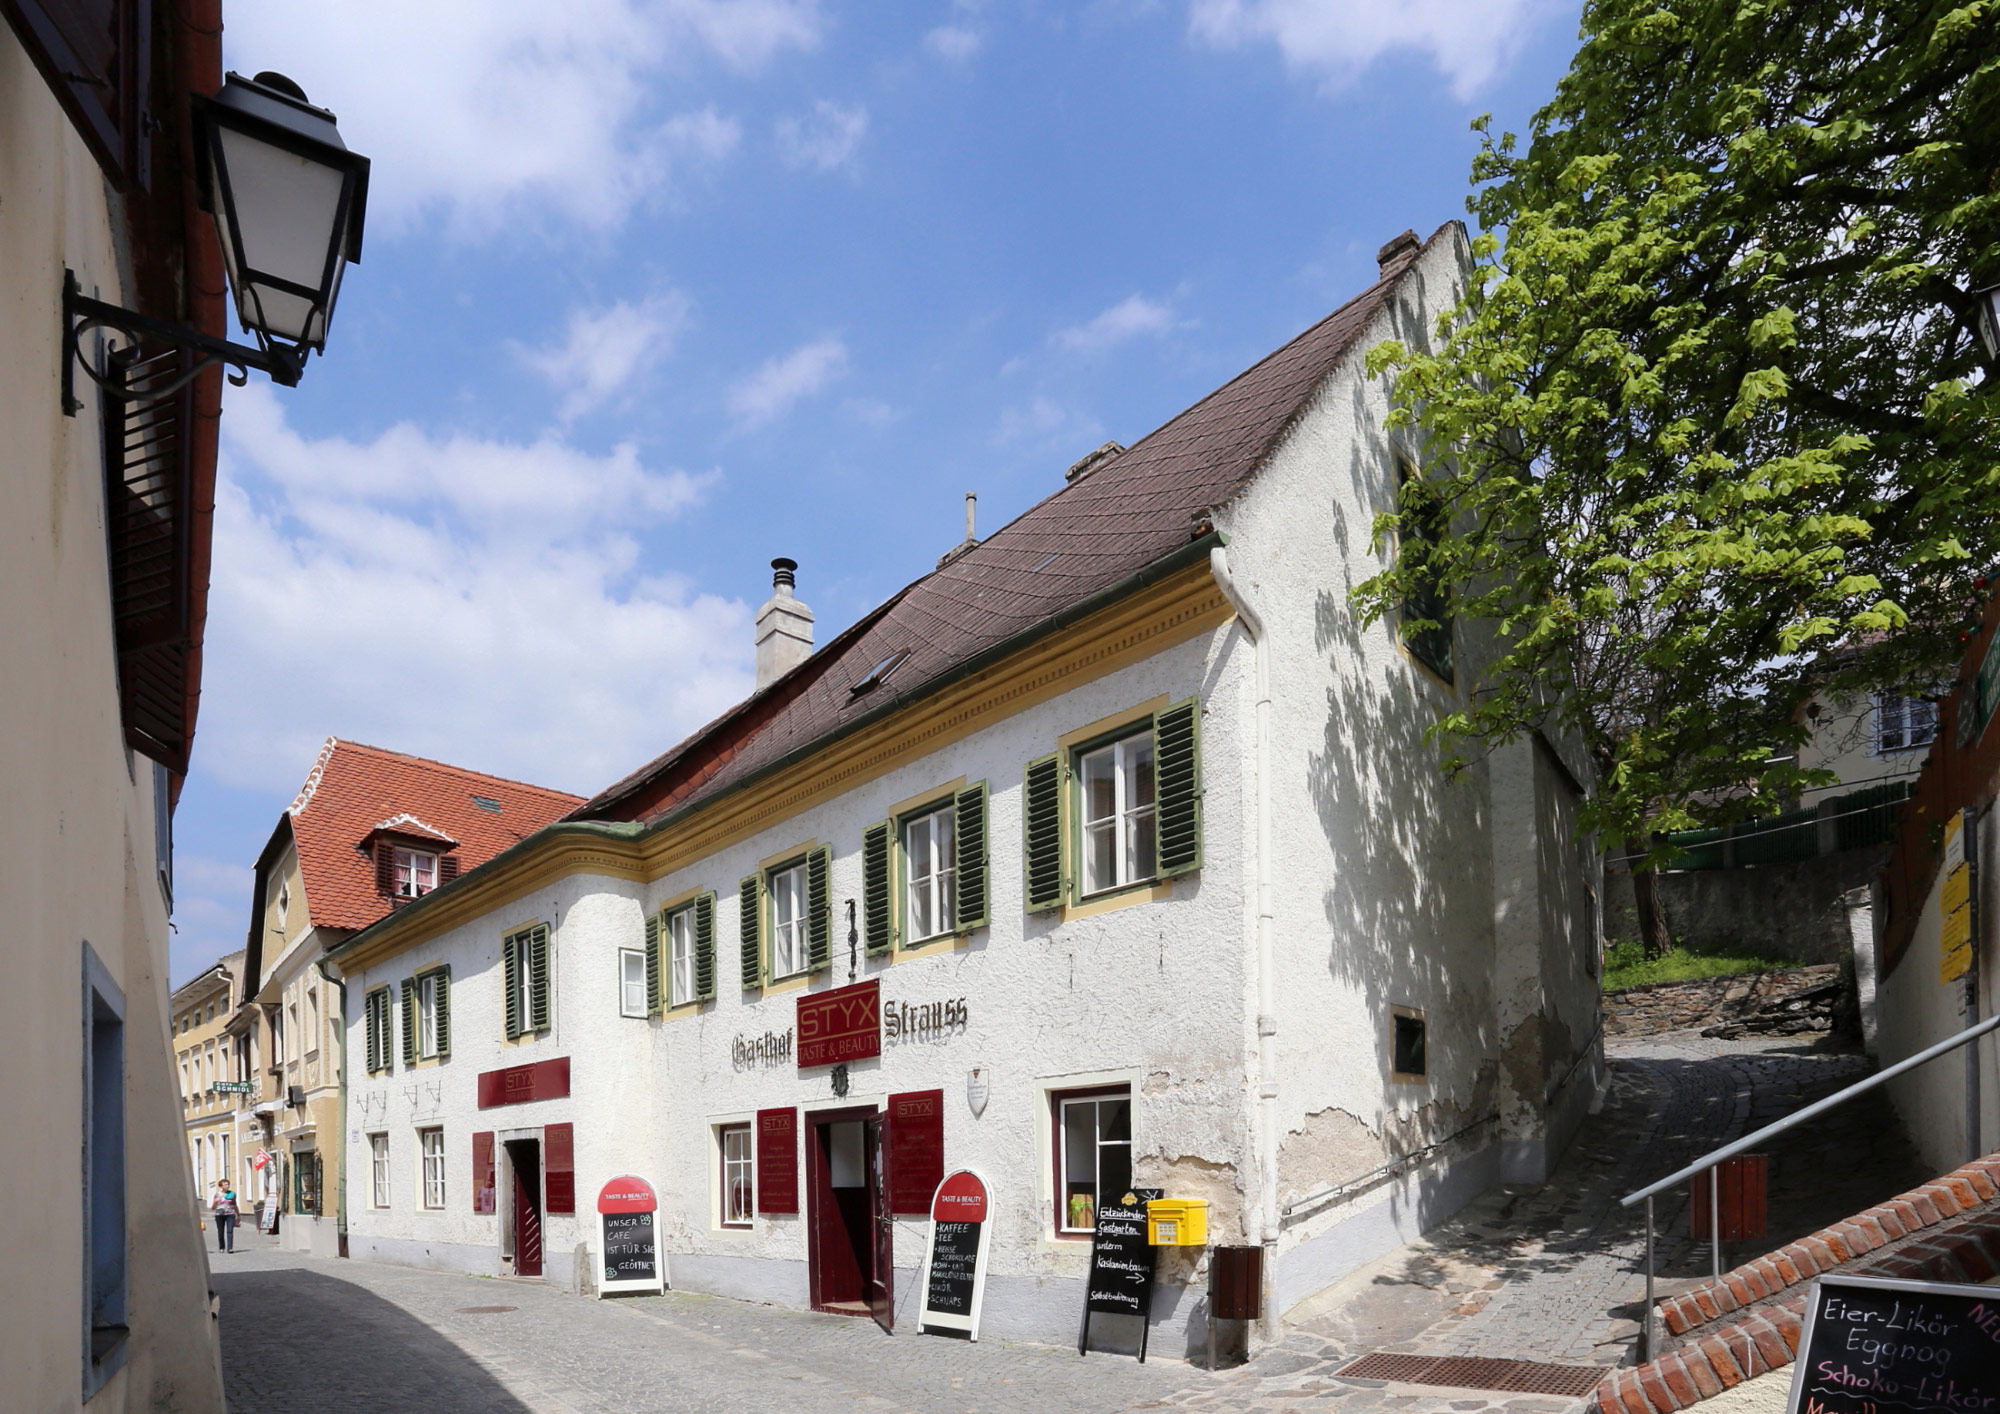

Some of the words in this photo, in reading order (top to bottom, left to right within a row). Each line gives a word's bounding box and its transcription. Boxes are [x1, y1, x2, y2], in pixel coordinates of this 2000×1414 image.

[801, 995, 876, 1037] STYX
[884, 996, 967, 1037] Strauss
[731, 1027, 793, 1064] Gasthof
[798, 1043, 825, 1061] TASTE
[828, 1041, 836, 1056] &
[840, 1034, 879, 1055] BEAUTY
[507, 1071, 534, 1089] STYX
[898, 1102, 931, 1116] STYX
[764, 1117, 789, 1129] STYX
[1100, 1206, 1146, 1220] Entzückender
[608, 1218, 638, 1227] UNSER
[939, 1222, 970, 1233] KAFFEE
[1098, 1221, 1140, 1236] Gastgarten
[607, 1227, 632, 1240] CAFÉ
[938, 1233, 953, 1242] TEE
[607, 1245, 619, 1255] IST
[623, 1242, 640, 1254] FÜR
[642, 1244, 655, 1254] SIE
[1096, 1241, 1122, 1251] unterm
[1096, 1254, 1150, 1272] Kastanienbaum
[931, 1294, 962, 1307] SCHNAPS
[1090, 1291, 1139, 1309] Selbstbedienung
[1823, 1298, 1959, 1336] Eier-Likör
[1846, 1327, 1951, 1378] Eggnog
[1817, 1361, 1996, 1409] Schoko-Likör
